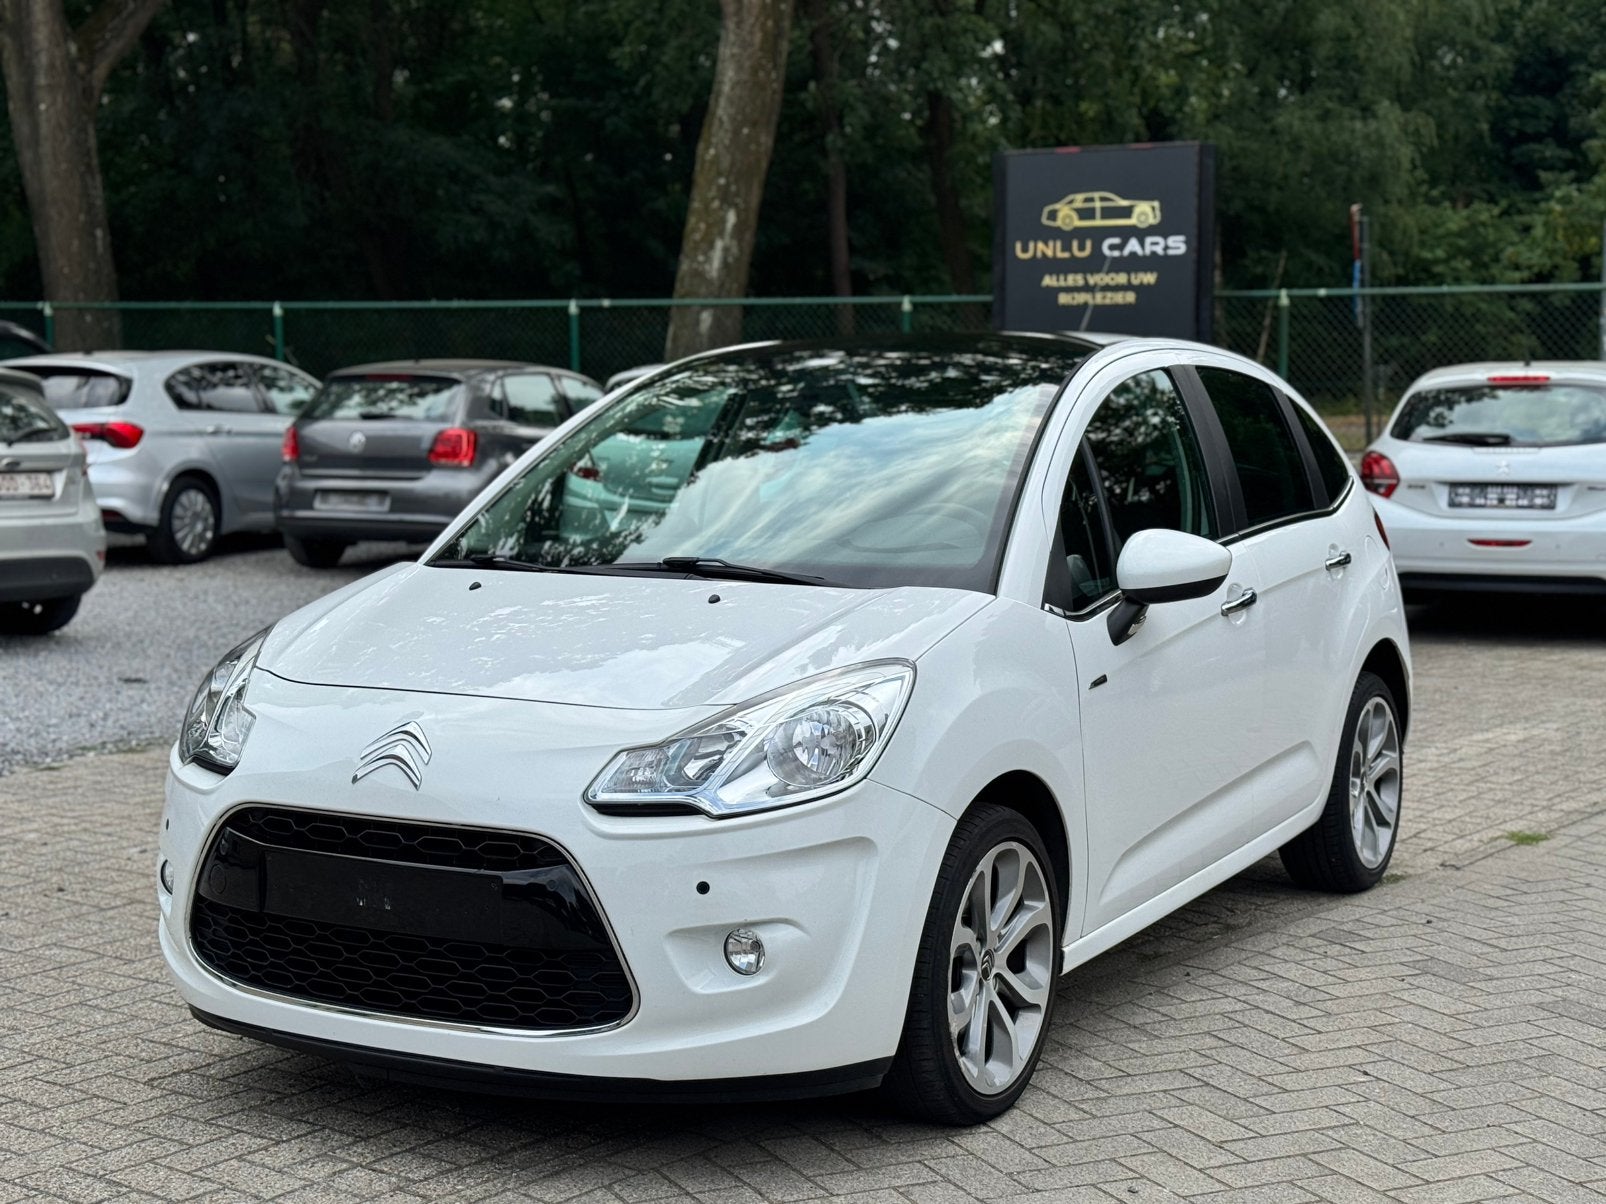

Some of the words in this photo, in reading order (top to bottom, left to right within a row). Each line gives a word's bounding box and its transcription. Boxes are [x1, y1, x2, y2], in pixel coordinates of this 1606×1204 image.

[1015, 238, 1092, 260] UNLU
[1101, 235, 1188, 257] CARS
[1041, 272, 1085, 287] ALLES
[1086, 272, 1128, 287] VOOR
[1130, 271, 1158, 286] UW
